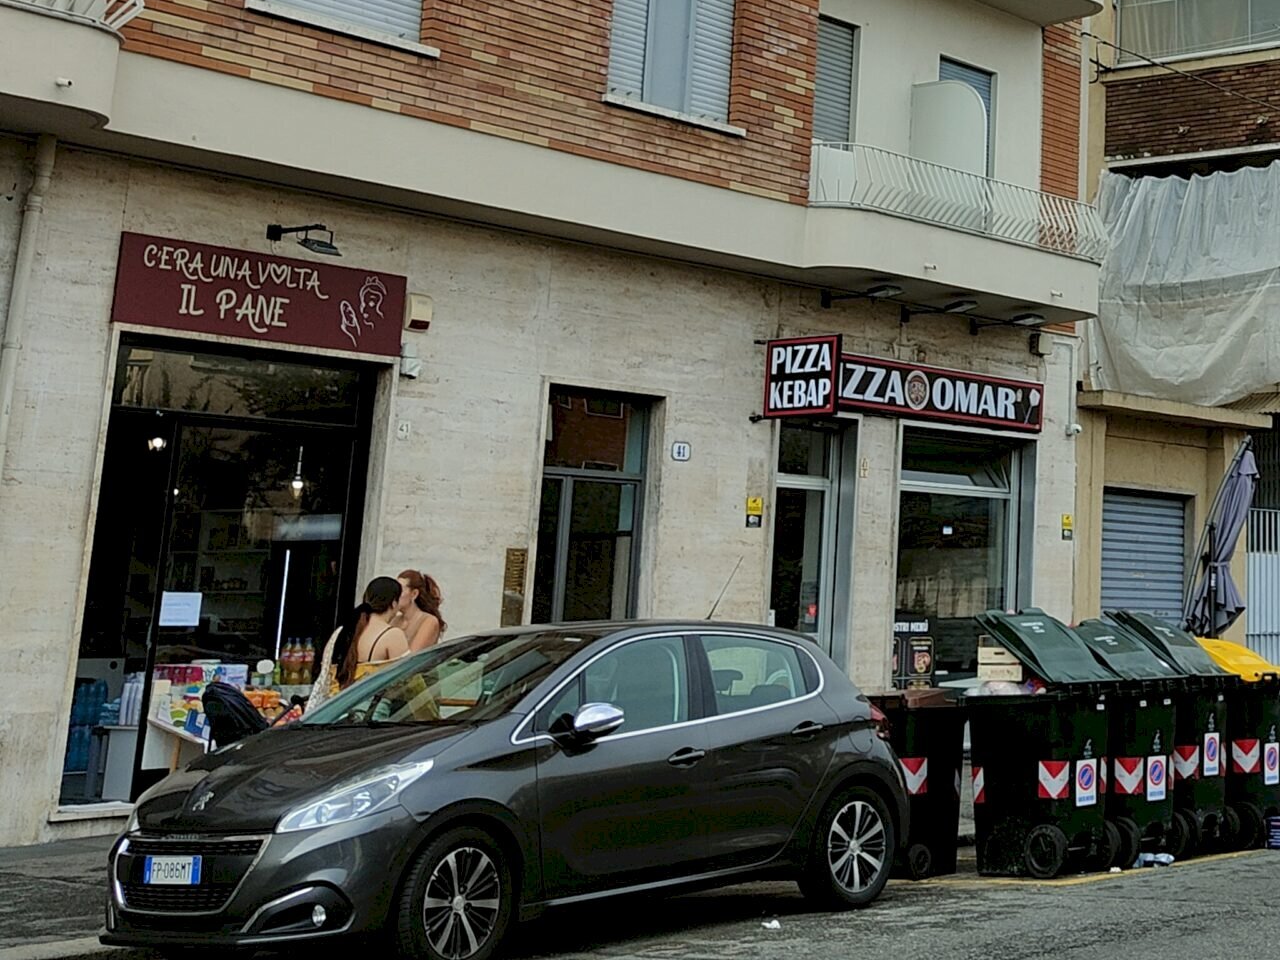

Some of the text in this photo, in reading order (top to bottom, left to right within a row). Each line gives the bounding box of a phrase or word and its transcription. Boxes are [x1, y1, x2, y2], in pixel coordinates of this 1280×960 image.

[143, 244, 213, 283] C'ERA
[210, 253, 261, 290] UNA
[178, 283, 291, 334] IL PANE
[771, 343, 832, 375] PIZZA
[769, 377, 832, 410] KEBAP
[838, 361, 1017, 420] IZZA OMAR
